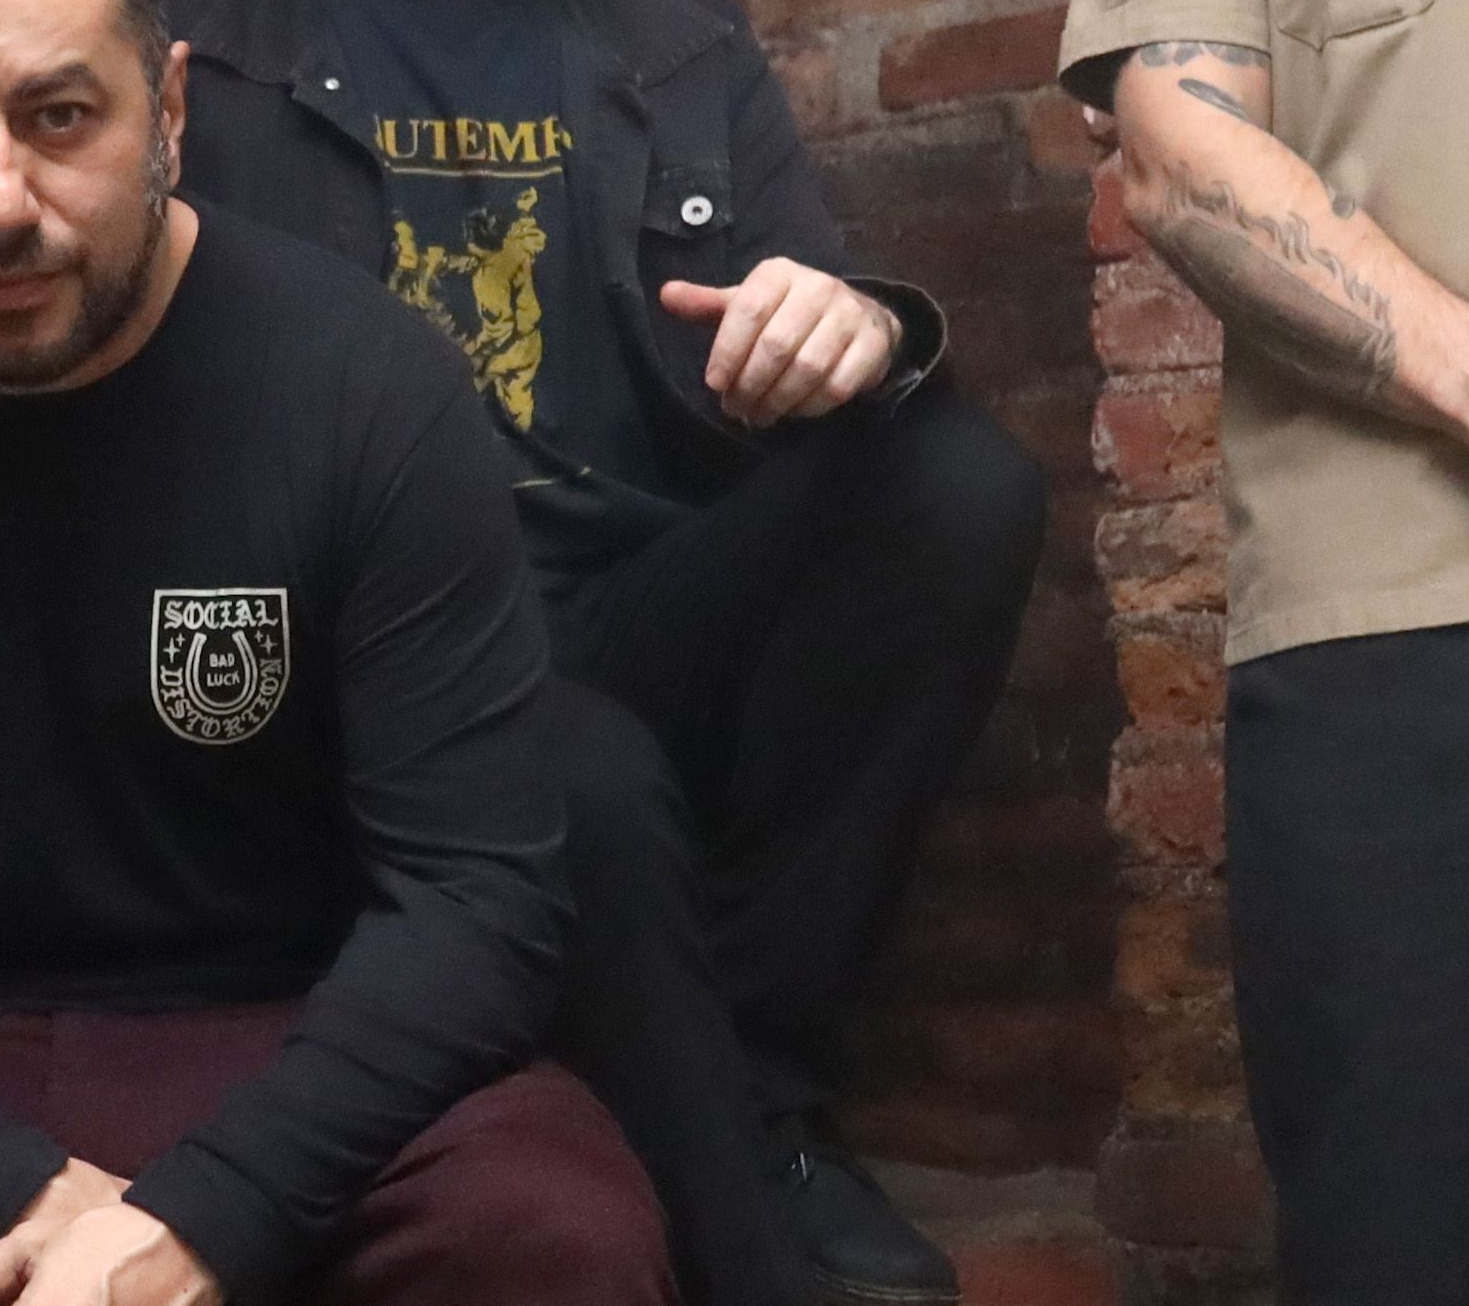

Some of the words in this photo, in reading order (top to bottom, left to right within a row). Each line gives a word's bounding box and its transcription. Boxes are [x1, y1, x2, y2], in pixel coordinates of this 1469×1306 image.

[163, 599, 279, 630] SOCIAL
[208, 653, 235, 668] BAD
[206, 671, 241, 687] LUCK
[160, 658, 282, 738] DISTORTION
